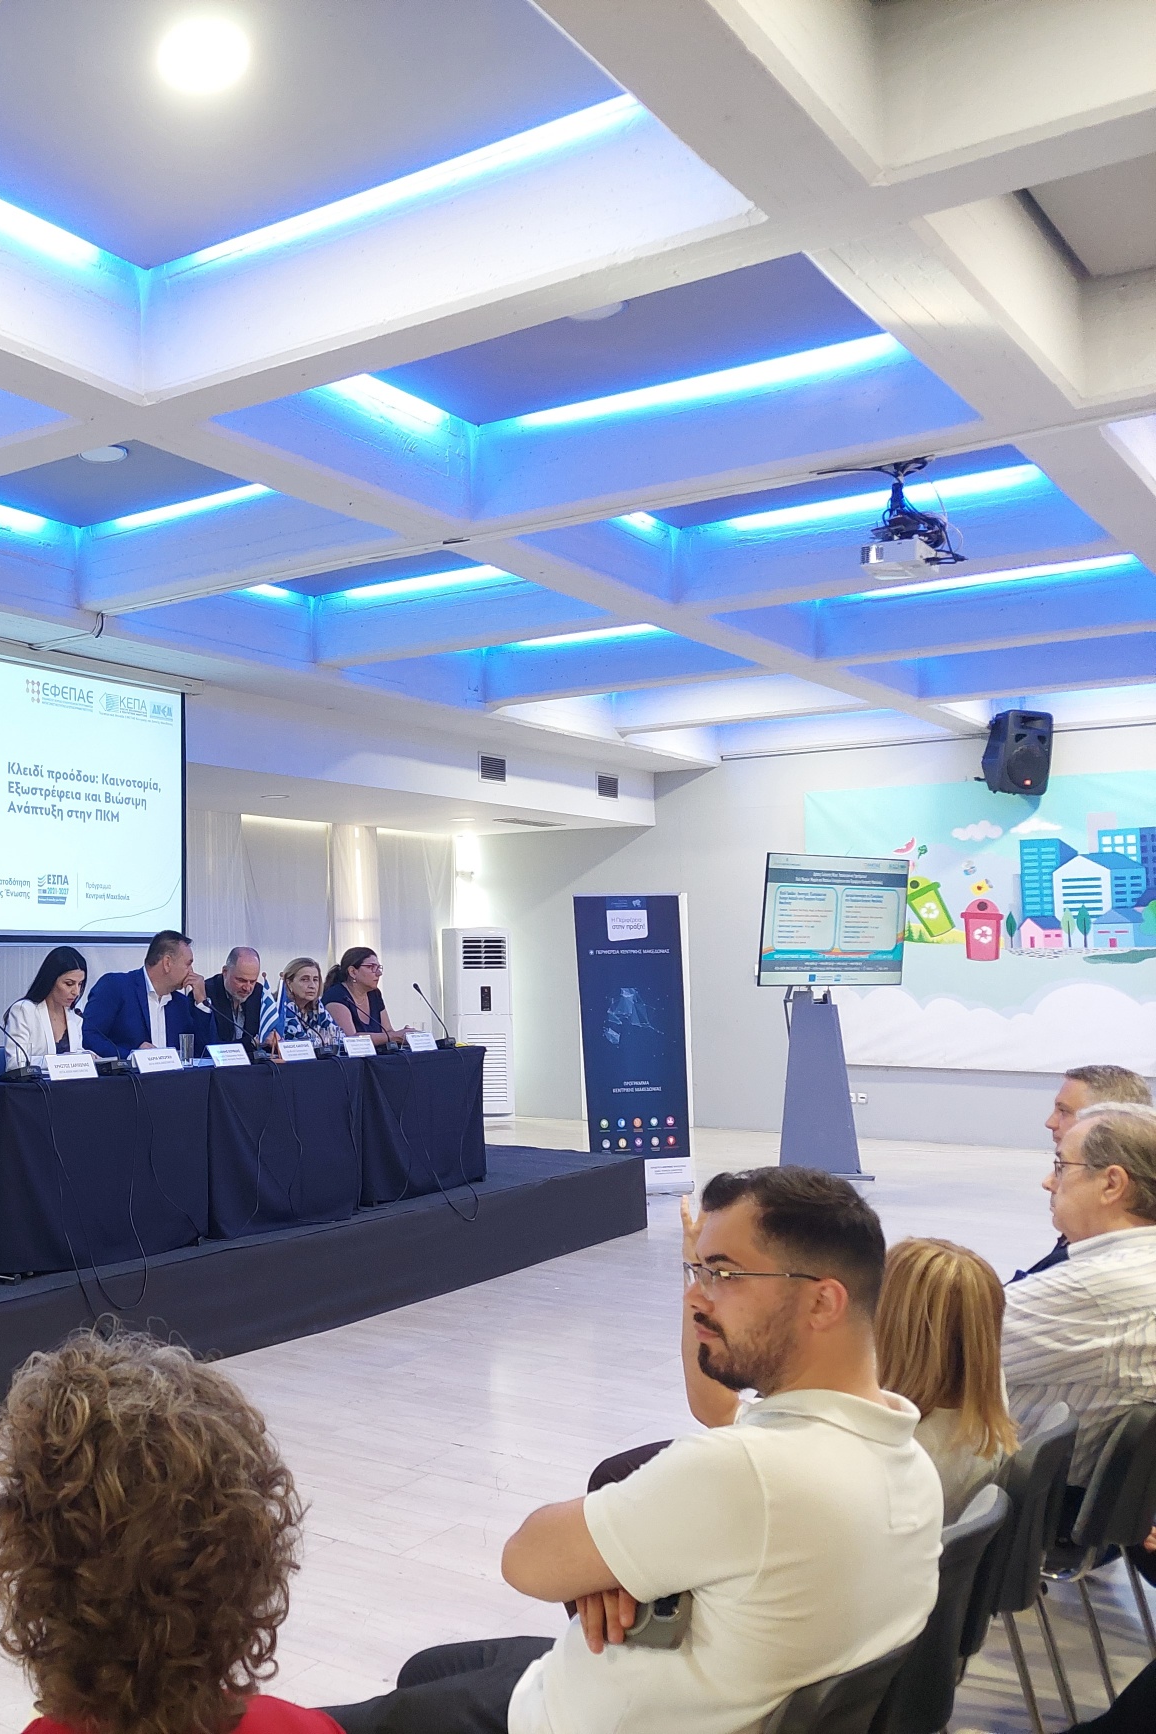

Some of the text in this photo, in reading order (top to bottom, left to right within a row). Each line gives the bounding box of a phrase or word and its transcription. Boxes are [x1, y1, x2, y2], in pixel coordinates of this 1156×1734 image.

[42, 682, 94, 704] ΕΦΕΠΑΕ
[119, 695, 148, 711] ΚΕΠΑ
[7, 762, 161, 793] Κλειδί προόδου: Καινοτομία,
[8, 781, 147, 810] Εξωστρέφεια και Βιώσιμη
[7, 801, 120, 823] Ανάπτυξη στην ΠΚΜ
[47, 874, 69, 885] ΕΣΠΑ
[85, 882, 112, 890] Πρόγραμμα
[4, 888, 30, 899] Ένωσης
[85, 892, 130, 901] Κεντρική Μακεδονία
